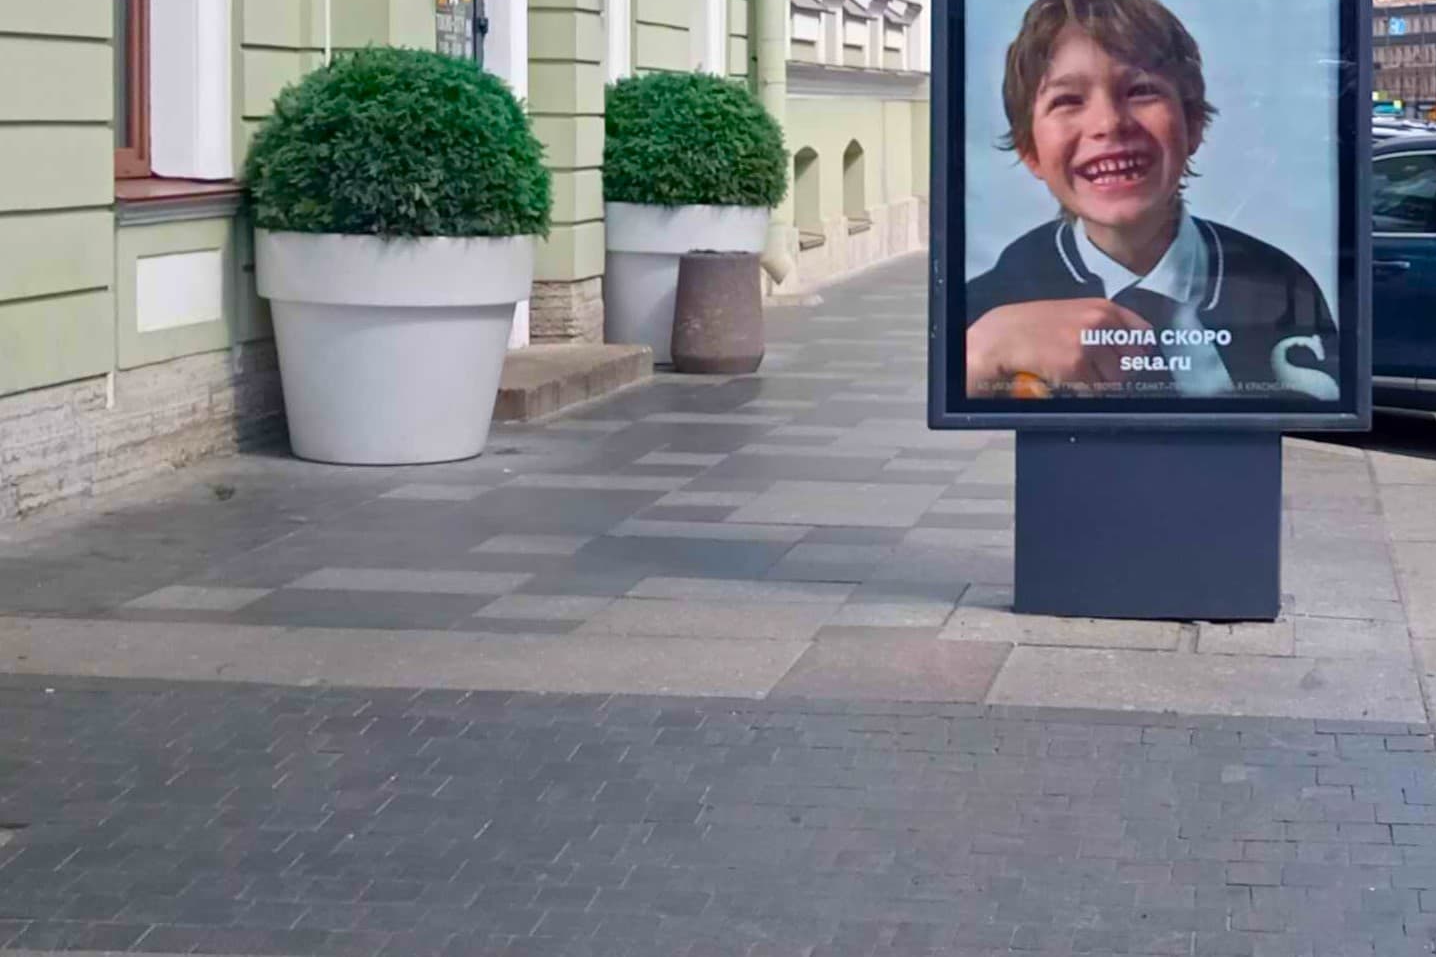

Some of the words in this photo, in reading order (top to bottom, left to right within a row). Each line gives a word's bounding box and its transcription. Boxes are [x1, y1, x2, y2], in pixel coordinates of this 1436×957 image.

[1080, 329, 1157, 346] ШКОЛА
[1160, 329, 1233, 346] СКОРО
[1120, 355, 1192, 371] sela.ru
